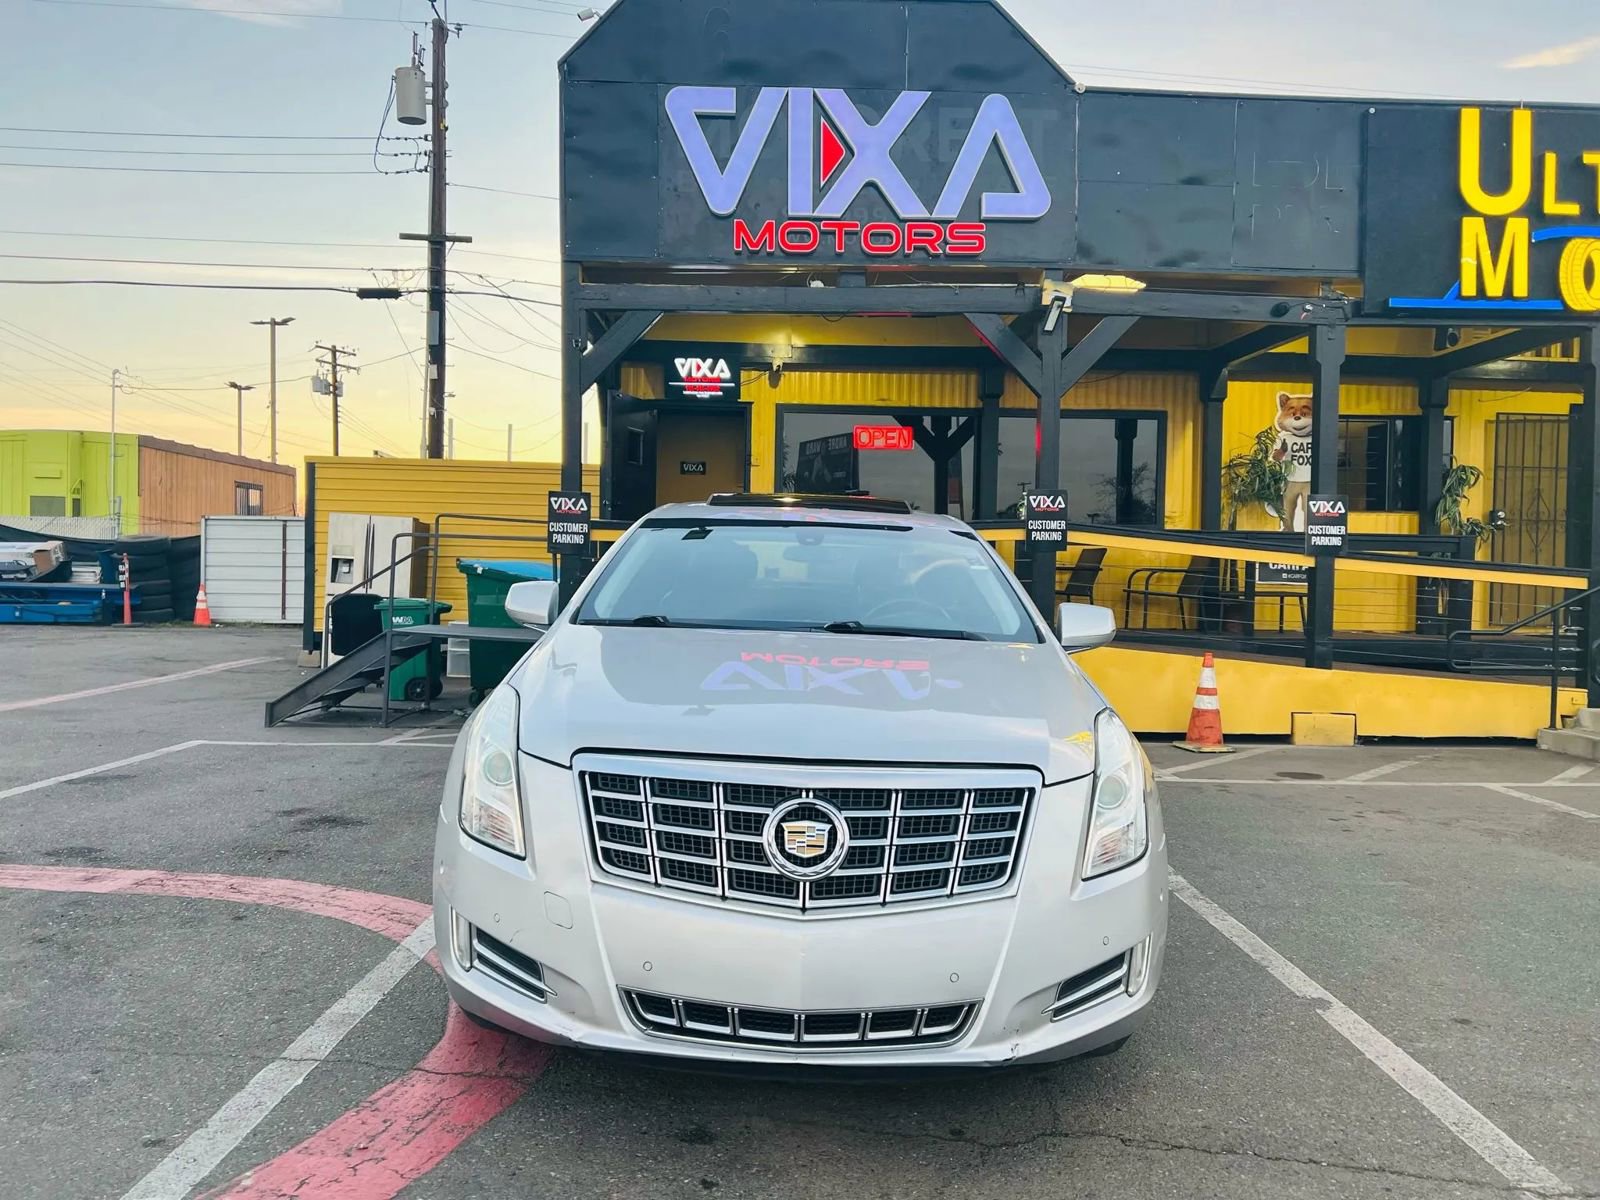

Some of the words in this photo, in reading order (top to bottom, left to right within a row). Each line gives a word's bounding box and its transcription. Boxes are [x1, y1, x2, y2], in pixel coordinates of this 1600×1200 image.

[665, 86, 1051, 220] VIXA
[734, 219, 986, 256] MOTORS
[674, 358, 731, 379] VIXA
[856, 428, 911, 448] OPEN
[683, 463, 704, 472] VIXA
[550, 497, 588, 511] VIXA
[1029, 495, 1066, 508] VIXA
[1309, 501, 1346, 513] VIXA
[549, 522, 588, 533] CUSTOMER
[1028, 520, 1066, 530] CUSTOMER
[1308, 525, 1346, 535] CUSTOMER
[552, 533, 584, 544] PARKING
[1031, 531, 1062, 541] PARKING
[1311, 536, 1342, 546] PARKING
